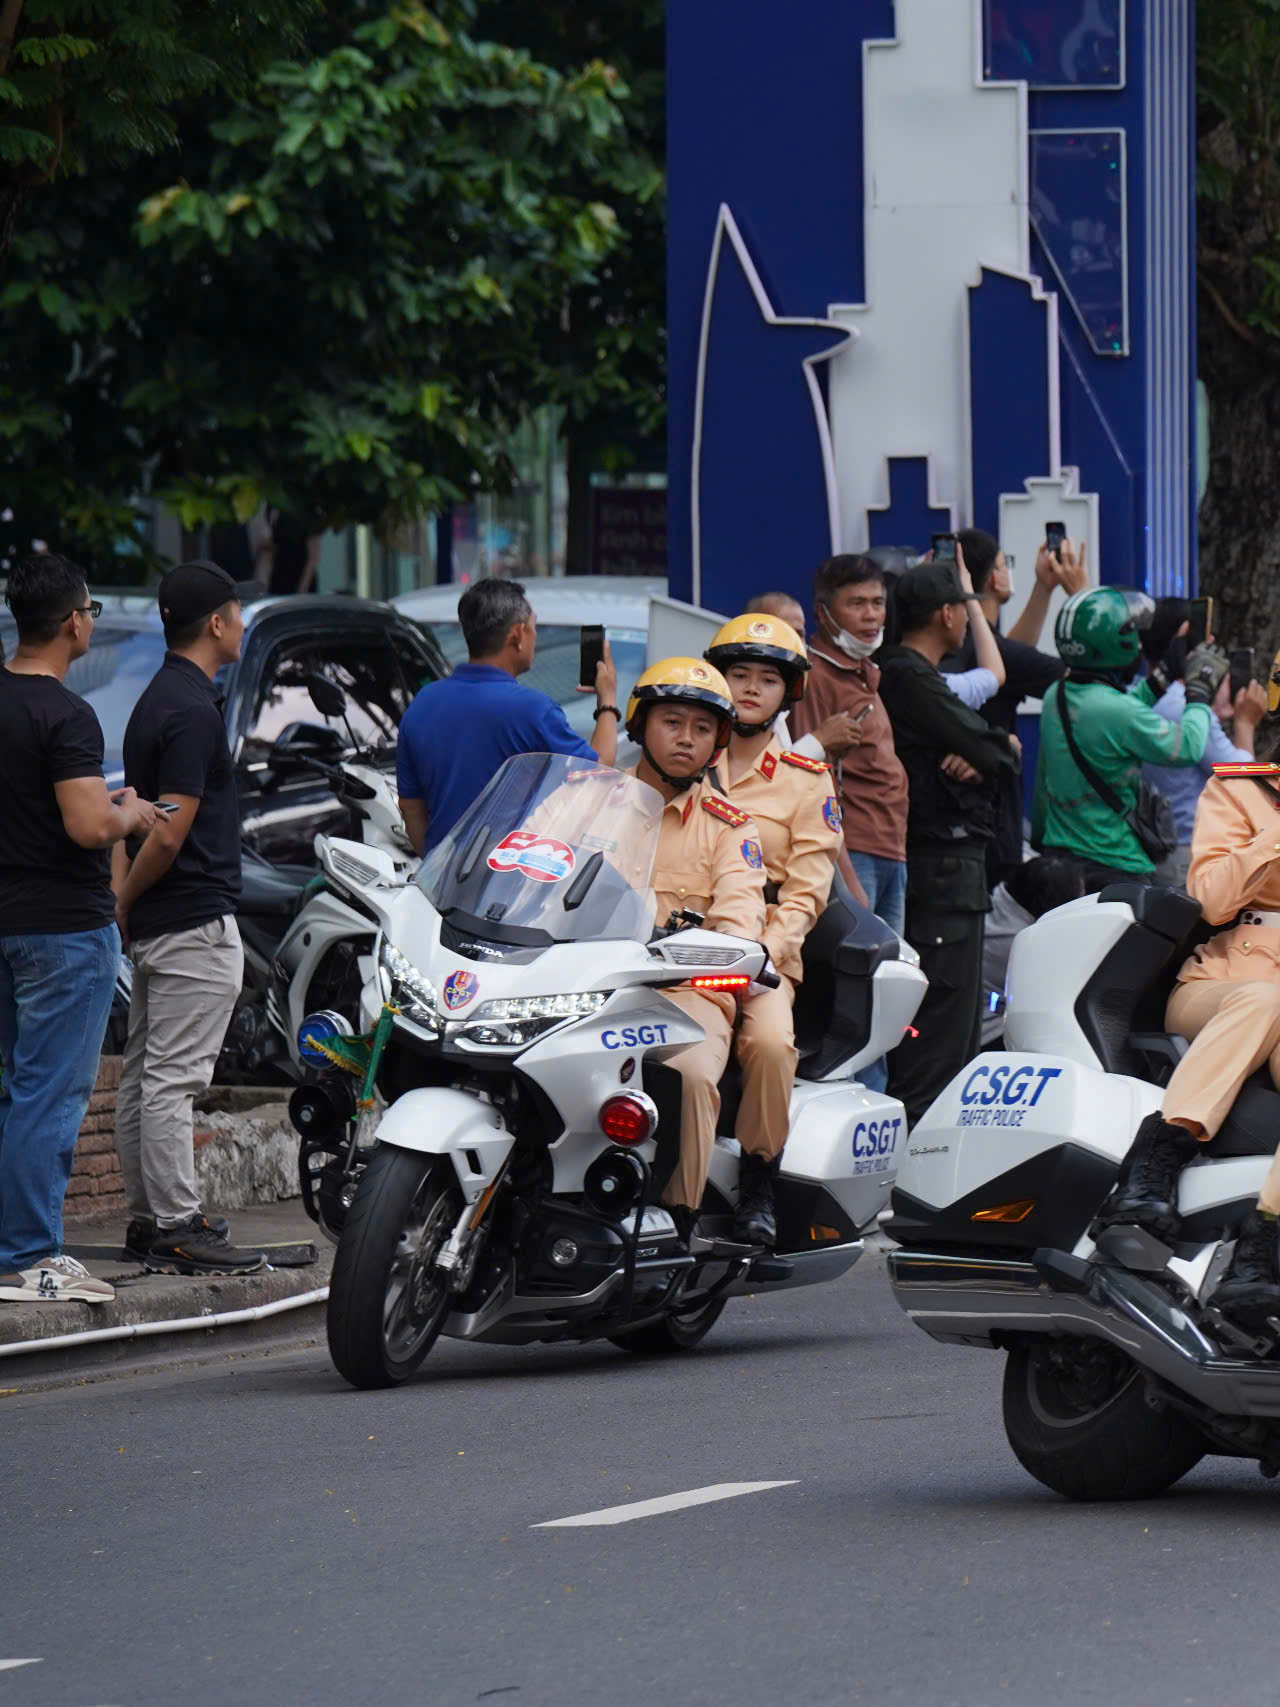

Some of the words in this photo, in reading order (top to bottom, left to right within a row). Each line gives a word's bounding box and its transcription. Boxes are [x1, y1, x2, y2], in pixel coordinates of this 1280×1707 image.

[601, 1024, 668, 1049] C.S.G.T
[960, 1065, 1063, 1106] C.S.G.T
[956, 1109, 994, 1127] TRAFFIC
[993, 1109, 1027, 1127] POLICE
